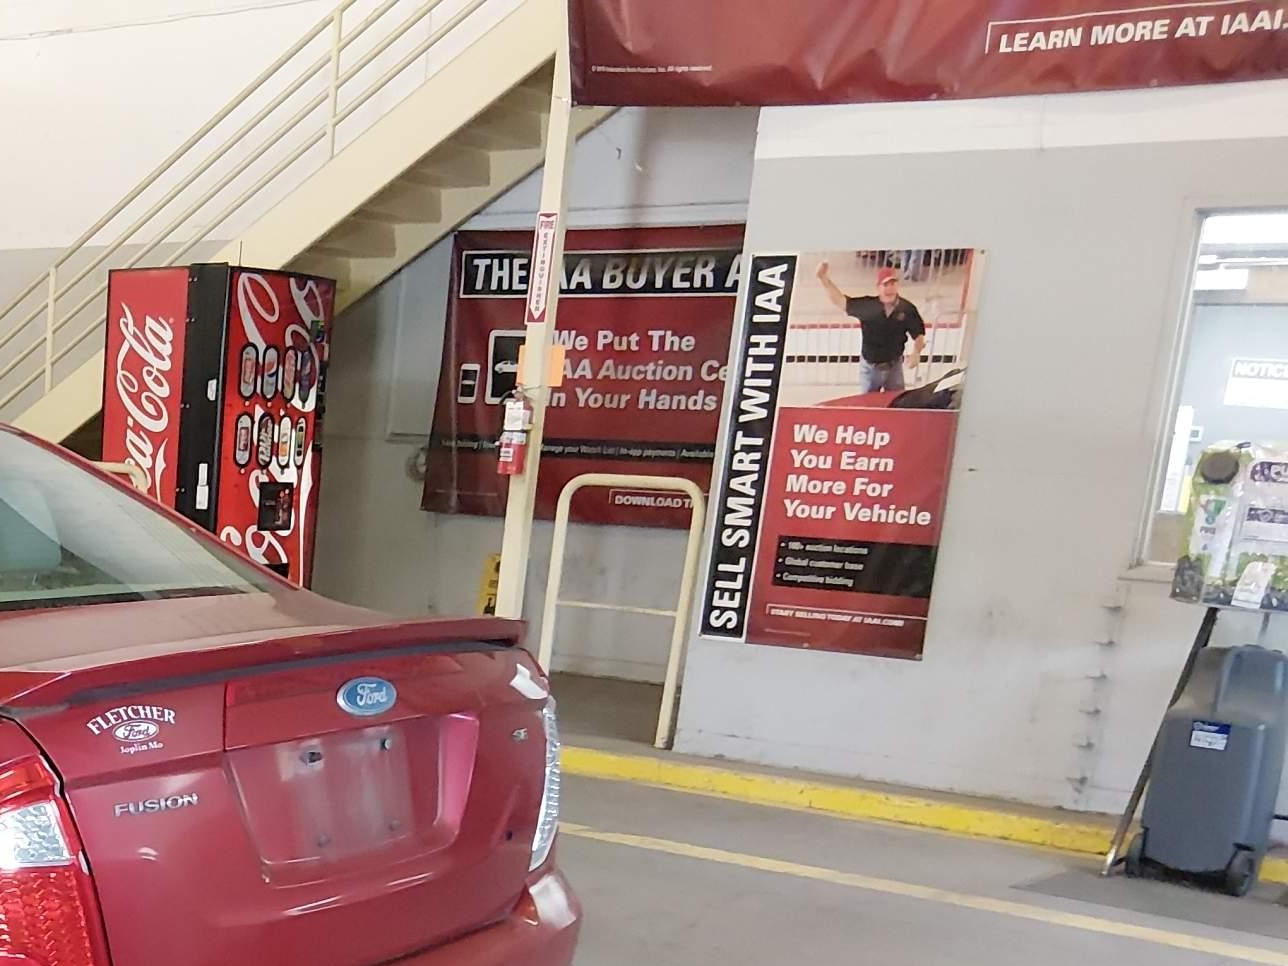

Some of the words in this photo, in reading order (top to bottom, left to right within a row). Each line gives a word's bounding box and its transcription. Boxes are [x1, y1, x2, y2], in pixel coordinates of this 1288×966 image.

[999, 27, 1082, 53] LEARN
[1090, 19, 1170, 46] MORE
[1174, 16, 1215, 39] AT
[473, 258, 529, 291] THE
[602, 255, 716, 289] BUYER
[724, 254, 744, 289] A
[752, 263, 789, 323] IAA
[553, 330, 589, 350] We
[597, 330, 640, 351] Put
[648, 330, 696, 352] The
[562, 358, 592, 380] AA
[596, 359, 693, 381] Auction
[700, 360, 729, 382] Ce
[738, 334, 779, 423] WITH
[575, 387, 631, 409] Your
[638, 389, 718, 411] Hands
[793, 424, 829, 444] We
[835, 425, 891, 450] Help
[790, 449, 833, 469] You
[840, 451, 894, 472] Earn
[721, 430, 765, 548] SMART
[785, 474, 846, 495] More
[853, 477, 894, 497] For
[615, 495, 683, 508] DOWNLOAD
[783, 498, 837, 520] Your
[843, 502, 932, 526] Vehicle
[709, 556, 747, 629] SELL
[356, 683, 389, 706] Ford
[87, 705, 176, 735] FLETCHER
[122, 724, 151, 738] Ford
[120, 743, 148, 754] Joplin
[114, 793, 199, 817] FUSION
